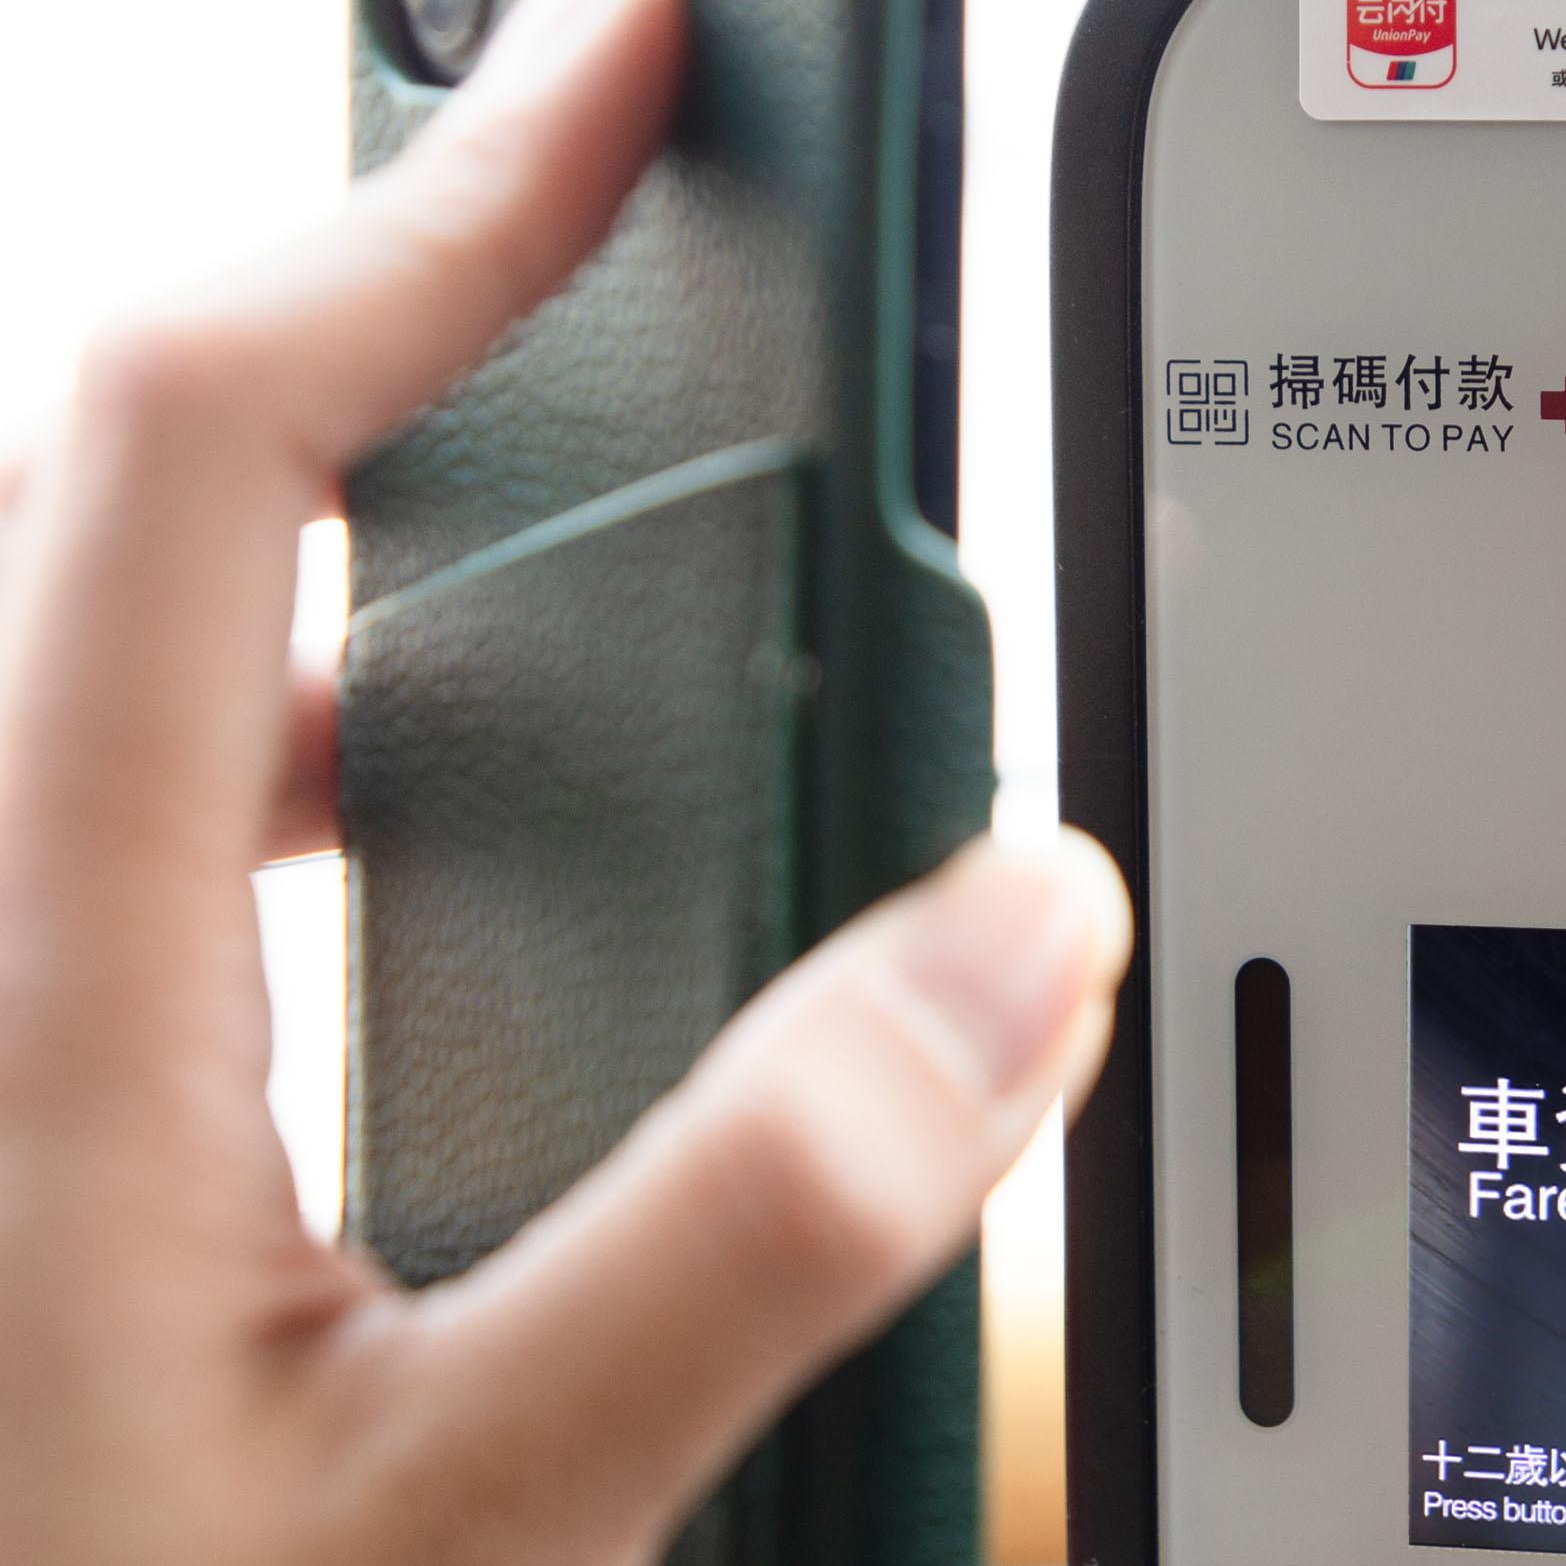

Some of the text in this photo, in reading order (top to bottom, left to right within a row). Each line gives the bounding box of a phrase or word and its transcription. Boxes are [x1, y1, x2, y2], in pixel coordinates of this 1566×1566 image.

[1372, 27, 1432, 44] UnionPay
[1269, 352, 1515, 412] 掃碼付款
[1271, 423, 1515, 453] SCAN TO PAY
[1423, 1491, 1497, 1521] Press
